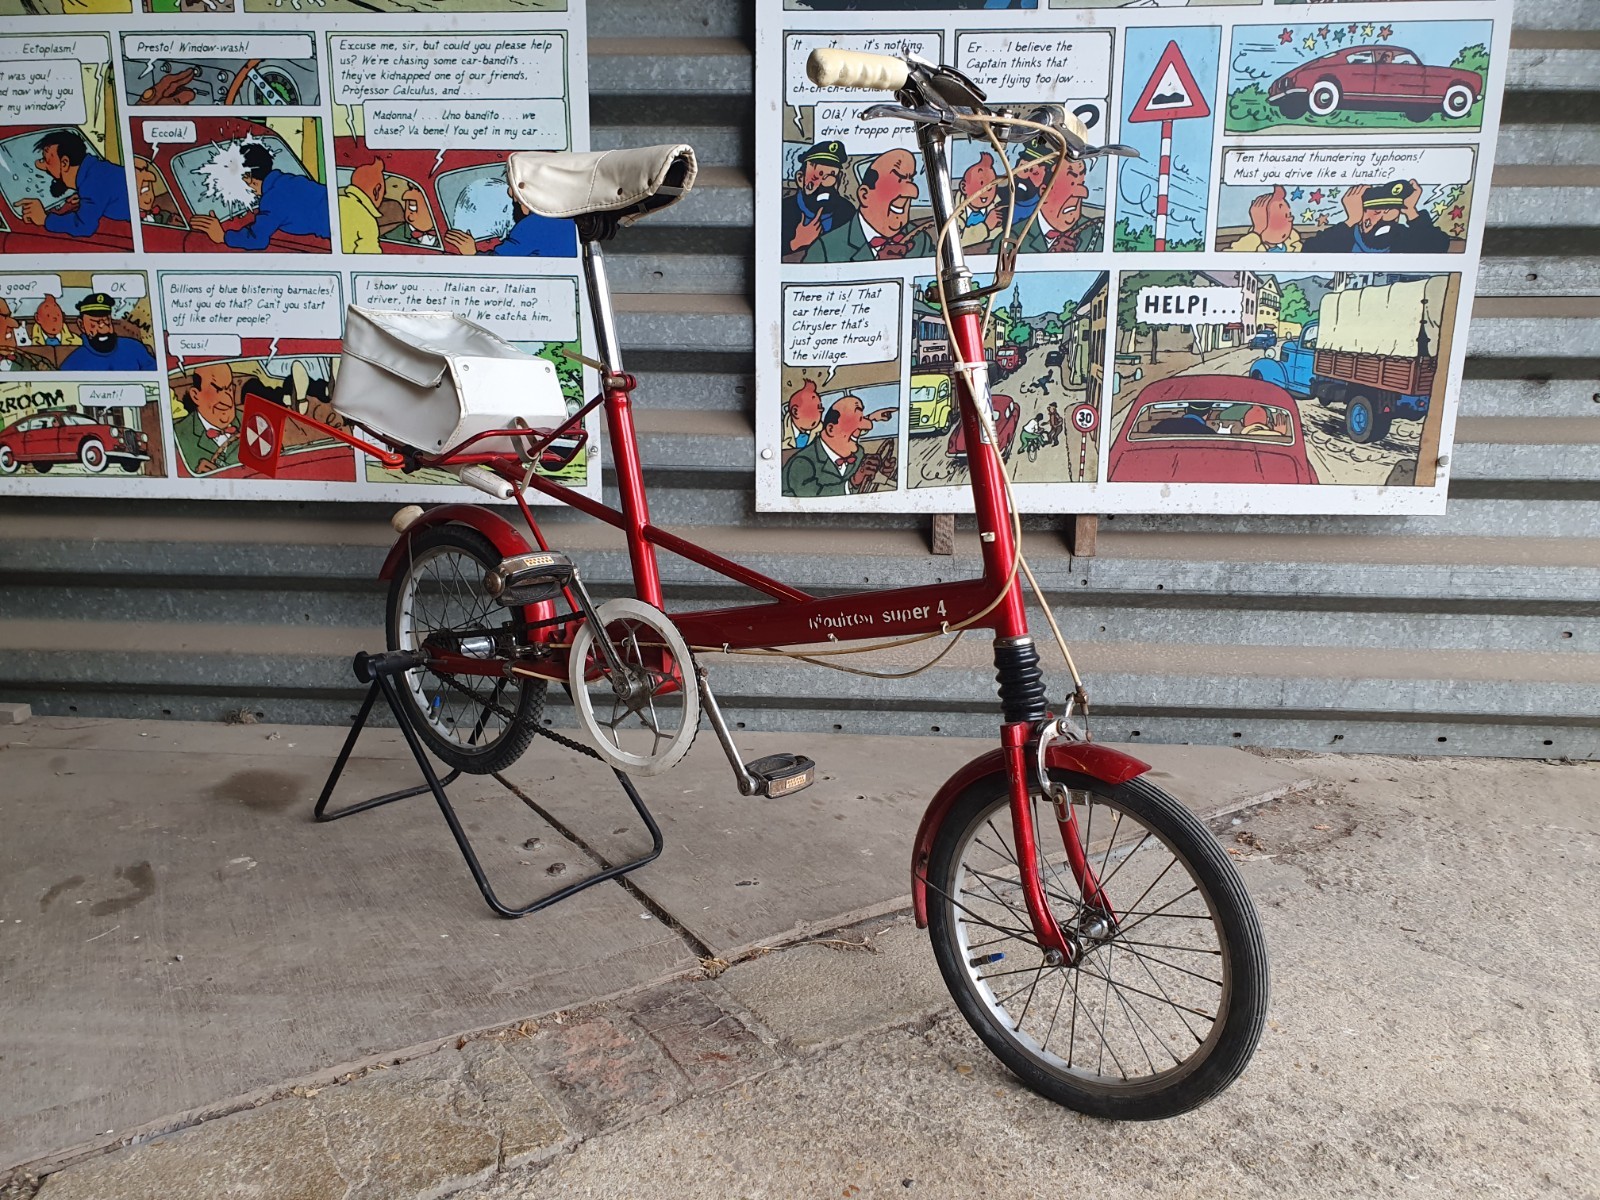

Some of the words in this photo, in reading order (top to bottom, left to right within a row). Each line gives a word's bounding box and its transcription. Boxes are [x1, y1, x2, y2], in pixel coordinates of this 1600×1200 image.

[23, 42, 76, 57] Ectoplasm!
[137, 41, 174, 53] Presto!
[179, 41, 249, 54] Window-wash!
[340, 40, 376, 50] Excuse
[380, 43, 397, 51] me,
[402, 41, 417, 51] sir,
[423, 40, 439, 50] but
[444, 40, 469, 50] could
[474, 43, 491, 55] you
[495, 41, 526, 55] please
[531, 39, 552, 53] help
[792, 39, 802, 50] It
[864, 39, 879, 50] it's
[884, 39, 924, 54] nothing.
[968, 42, 982, 53] Er
[1015, 41, 1052, 52] believe
[1057, 40, 1072, 51] the
[340, 55, 357, 66] us?
[362, 55, 389, 65] We're
[393, 55, 429, 70] chasing
[461, 55, 518, 65] car-bandits
[966, 58, 1007, 73] Captain
[1011, 57, 1041, 68] thinks
[1047, 56, 1068, 67] that
[30, 69, 51, 84] you!
[342, 70, 376, 84] they've
[381, 70, 430, 84] kidnapped
[455, 70, 465, 84] of
[490, 70, 527, 84] friends,
[973, 74, 998, 84] ou're
[999, 74, 1031, 88] flying
[1036, 73, 1052, 84] too
[1055, 74, 1074, 84] low
[34, 85, 52, 99] why
[56, 89, 73, 100] you
[342, 85, 390, 99] Professor
[393, 85, 437, 95] Calculus,
[442, 86, 460, 95] and
[7, 105, 21, 115] my
[25, 100, 66, 111] window?
[852, 109, 863, 119] Yo
[373, 110, 417, 121] Madonna!
[442, 111, 461, 120] Uno
[465, 110, 499, 120] bandito
[374, 125, 405, 136] chase?
[409, 125, 419, 135] Va
[423, 125, 449, 136] bene!
[454, 125, 469, 135] You
[472, 126, 488, 139] get
[492, 126, 500, 135] in
[504, 129, 518, 139] my
[821, 126, 849, 136] drive
[855, 126, 889, 139] troppo
[892, 126, 916, 138] pres
[1236, 152, 1254, 162] Ten
[1258, 150, 1305, 162] thousand
[1309, 150, 1366, 168] thundering
[1369, 149, 1425, 168] typhoons!
[1234, 168, 1259, 179] Must
[1263, 171, 1281, 183] you
[1286, 168, 1313, 178] drive
[1317, 167, 1337, 178] like
[1352, 166, 1395, 180] lunatic?
[6, 281, 37, 295] good?
[111, 282, 126, 292] OK
[170, 284, 202, 293] Billions
[206, 284, 215, 297] of
[219, 285, 238, 293] blue
[242, 284, 283, 298] blistering
[287, 283, 334, 296] barnacles!
[374, 282, 398, 290] show
[401, 285, 418, 295] you
[444, 282, 475, 292] Italian
[480, 286, 499, 294] car,
[505, 284, 536, 293] Italian
[367, 295, 401, 304] driver,
[407, 295, 421, 304] the
[426, 296, 447, 306] best
[451, 297, 459, 305] in
[465, 296, 480, 306] the
[484, 298, 515, 307] world,
[521, 298, 538, 308] no?
[793, 291, 822, 302] There
[826, 291, 835, 301] it
[838, 289, 852, 302] is!
[858, 288, 882, 299] That
[171, 299, 192, 308] Must
[195, 302, 211, 315] you
[215, 300, 226, 308] do
[230, 298, 252, 309] that?
[257, 299, 280, 308] Can't
[284, 303, 299, 313] you
[303, 300, 325, 309] start
[813, 304, 846, 317] there!
[852, 303, 870, 315] The
[121, 311, 151, 333] SLAM
[173, 313, 186, 326] off
[190, 313, 206, 322] like
[209, 313, 233, 322] other
[236, 314, 271, 326] people?
[477, 311, 491, 320] We
[495, 311, 527, 321] catcha
[532, 311, 551, 322] him,
[792, 320, 837, 335] Chrysler
[841, 317, 868, 329] that's
[180, 339, 208, 349] Scusi!
[789, 336, 811, 350] just
[813, 338, 838, 349] gone
[843, 332, 882, 346] through
[792, 349, 808, 360] the
[812, 348, 849, 364] village.
[90, 389, 123, 400] Avanti!
[1078, 412, 1092, 424] 30
[882, 605, 930, 623] super
[936, 599, 947, 617] 4
